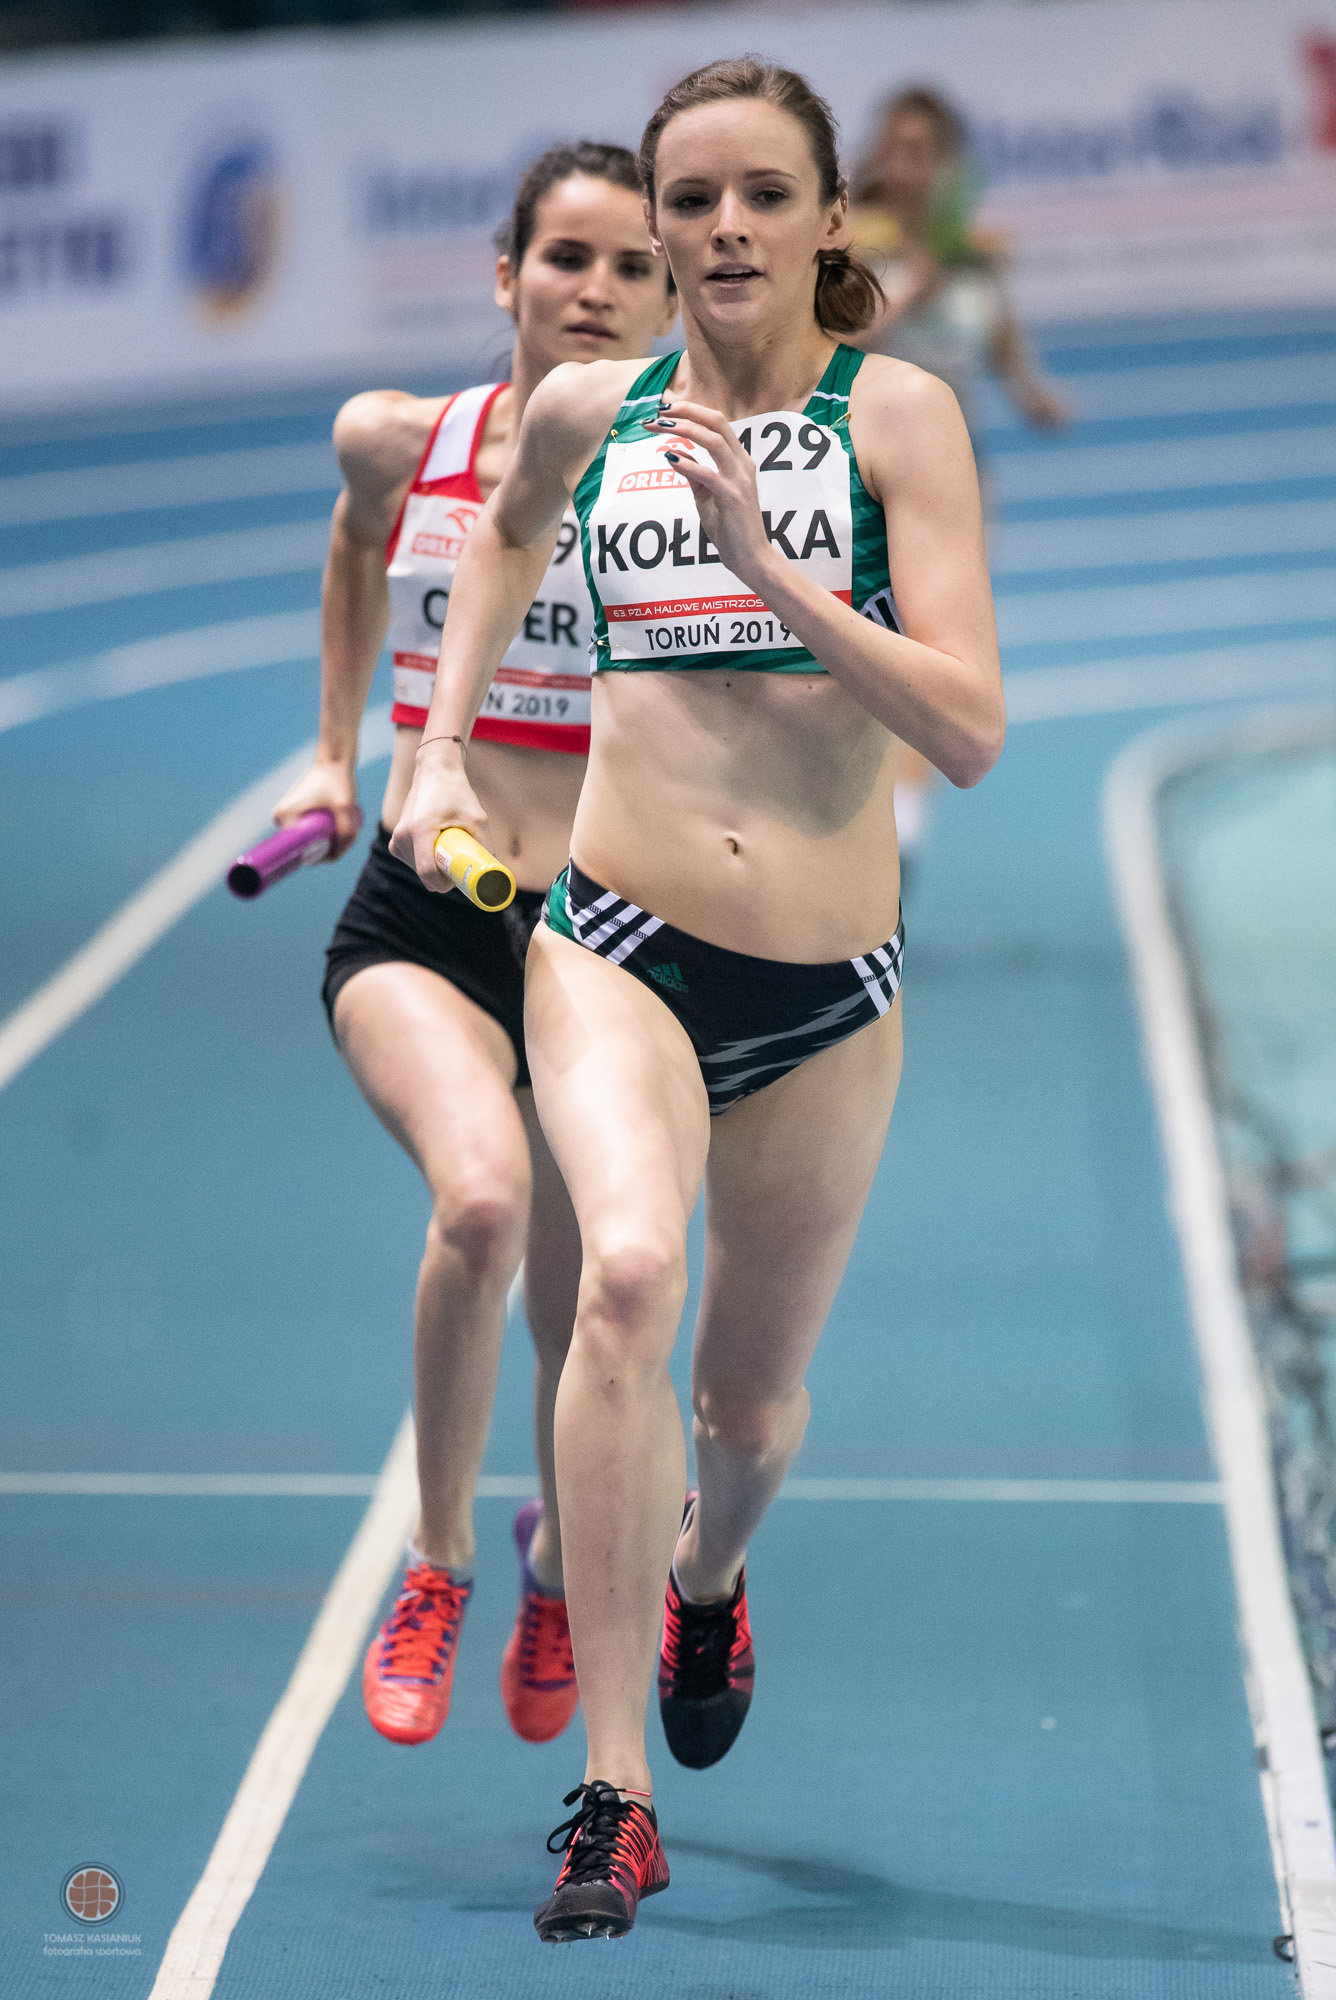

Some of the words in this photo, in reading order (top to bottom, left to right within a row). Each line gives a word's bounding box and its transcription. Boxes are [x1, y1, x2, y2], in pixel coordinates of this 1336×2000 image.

[597, 509, 841, 574] KOŁEKA
[628, 607, 652, 617] PZLA
[654, 602, 699, 614] HALOWE
[702, 599, 765, 610] MISTRZOS
[645, 616, 720, 651] TORUŃ
